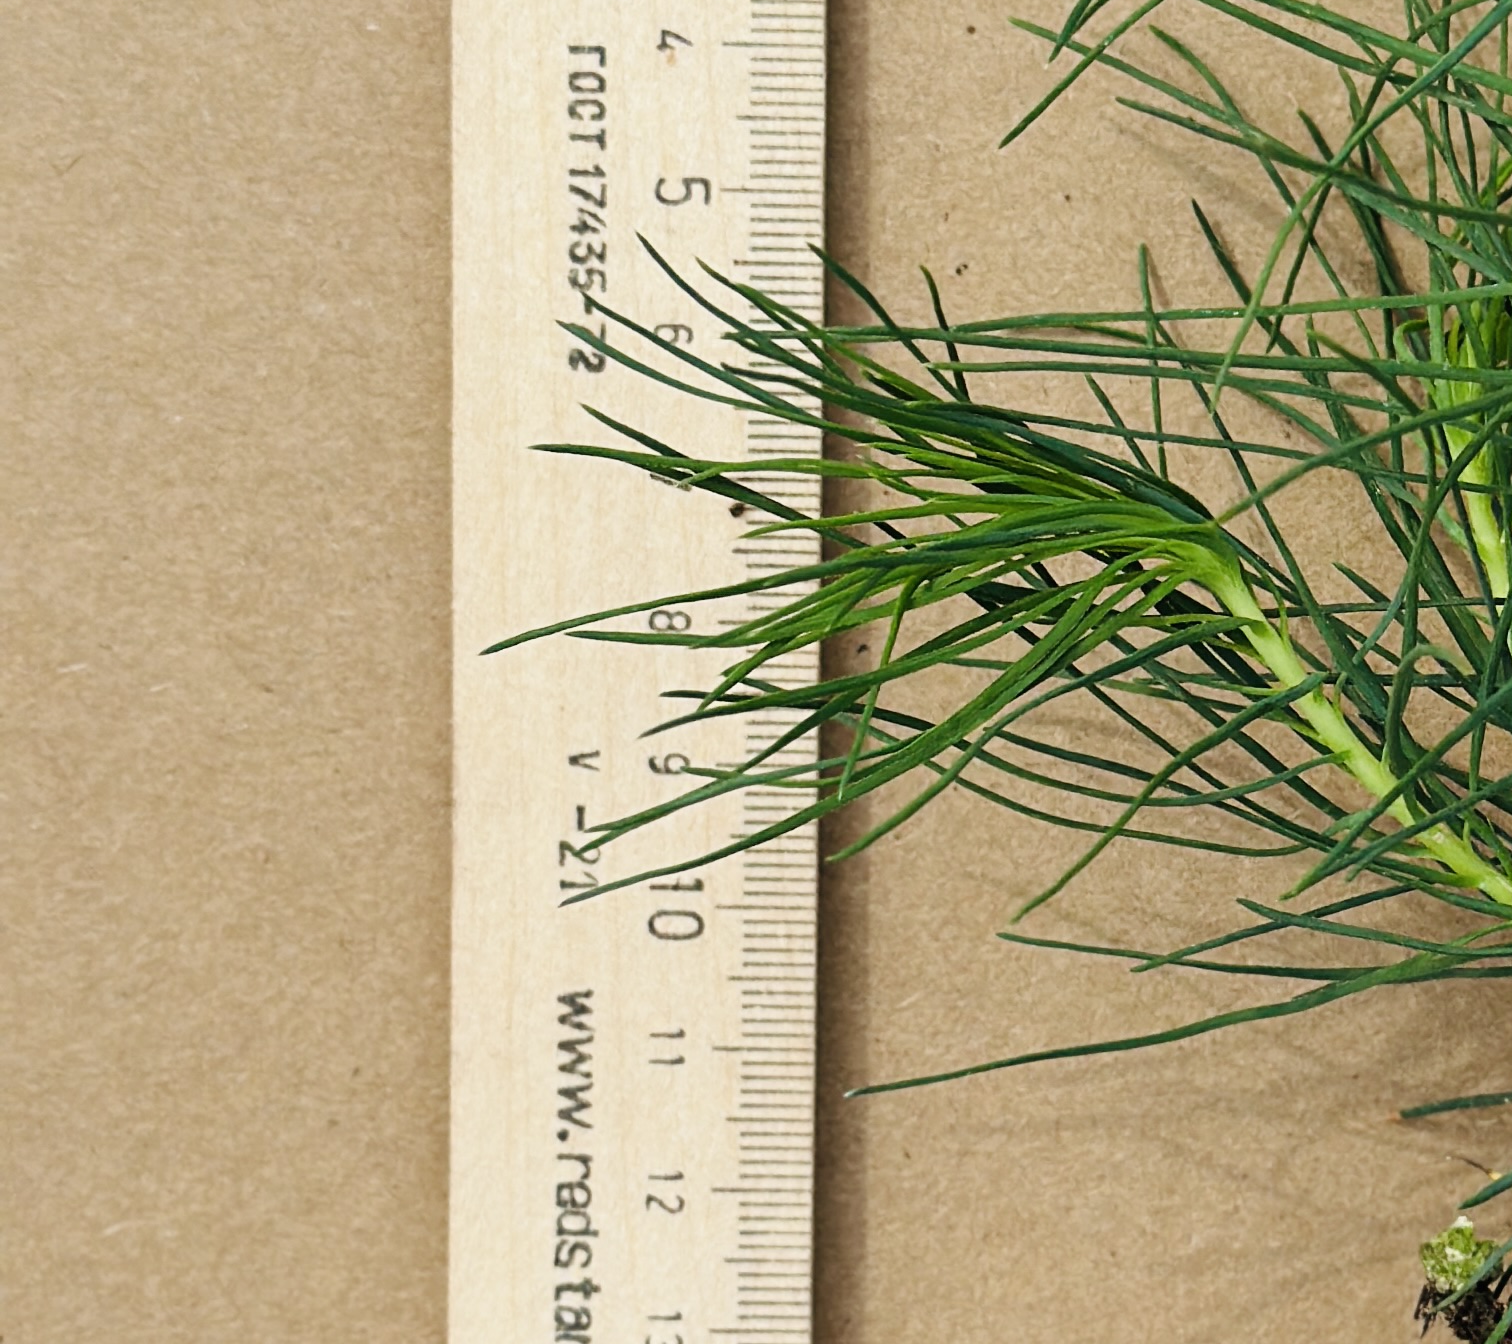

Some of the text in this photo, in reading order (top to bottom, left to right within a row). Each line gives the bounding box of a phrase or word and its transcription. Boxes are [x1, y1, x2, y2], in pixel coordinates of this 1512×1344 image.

[655, 28, 694, 53] 4
[566, 44, 608, 152] ГОСТ
[653, 176, 712, 207] 5
[652, 322, 694, 346] 6
[648, 609, 692, 633] 8
[648, 752, 691, 775] 9
[647, 877, 706, 942] 10
[648, 1028, 687, 1067] 11
[644, 1170, 686, 1215] 12
